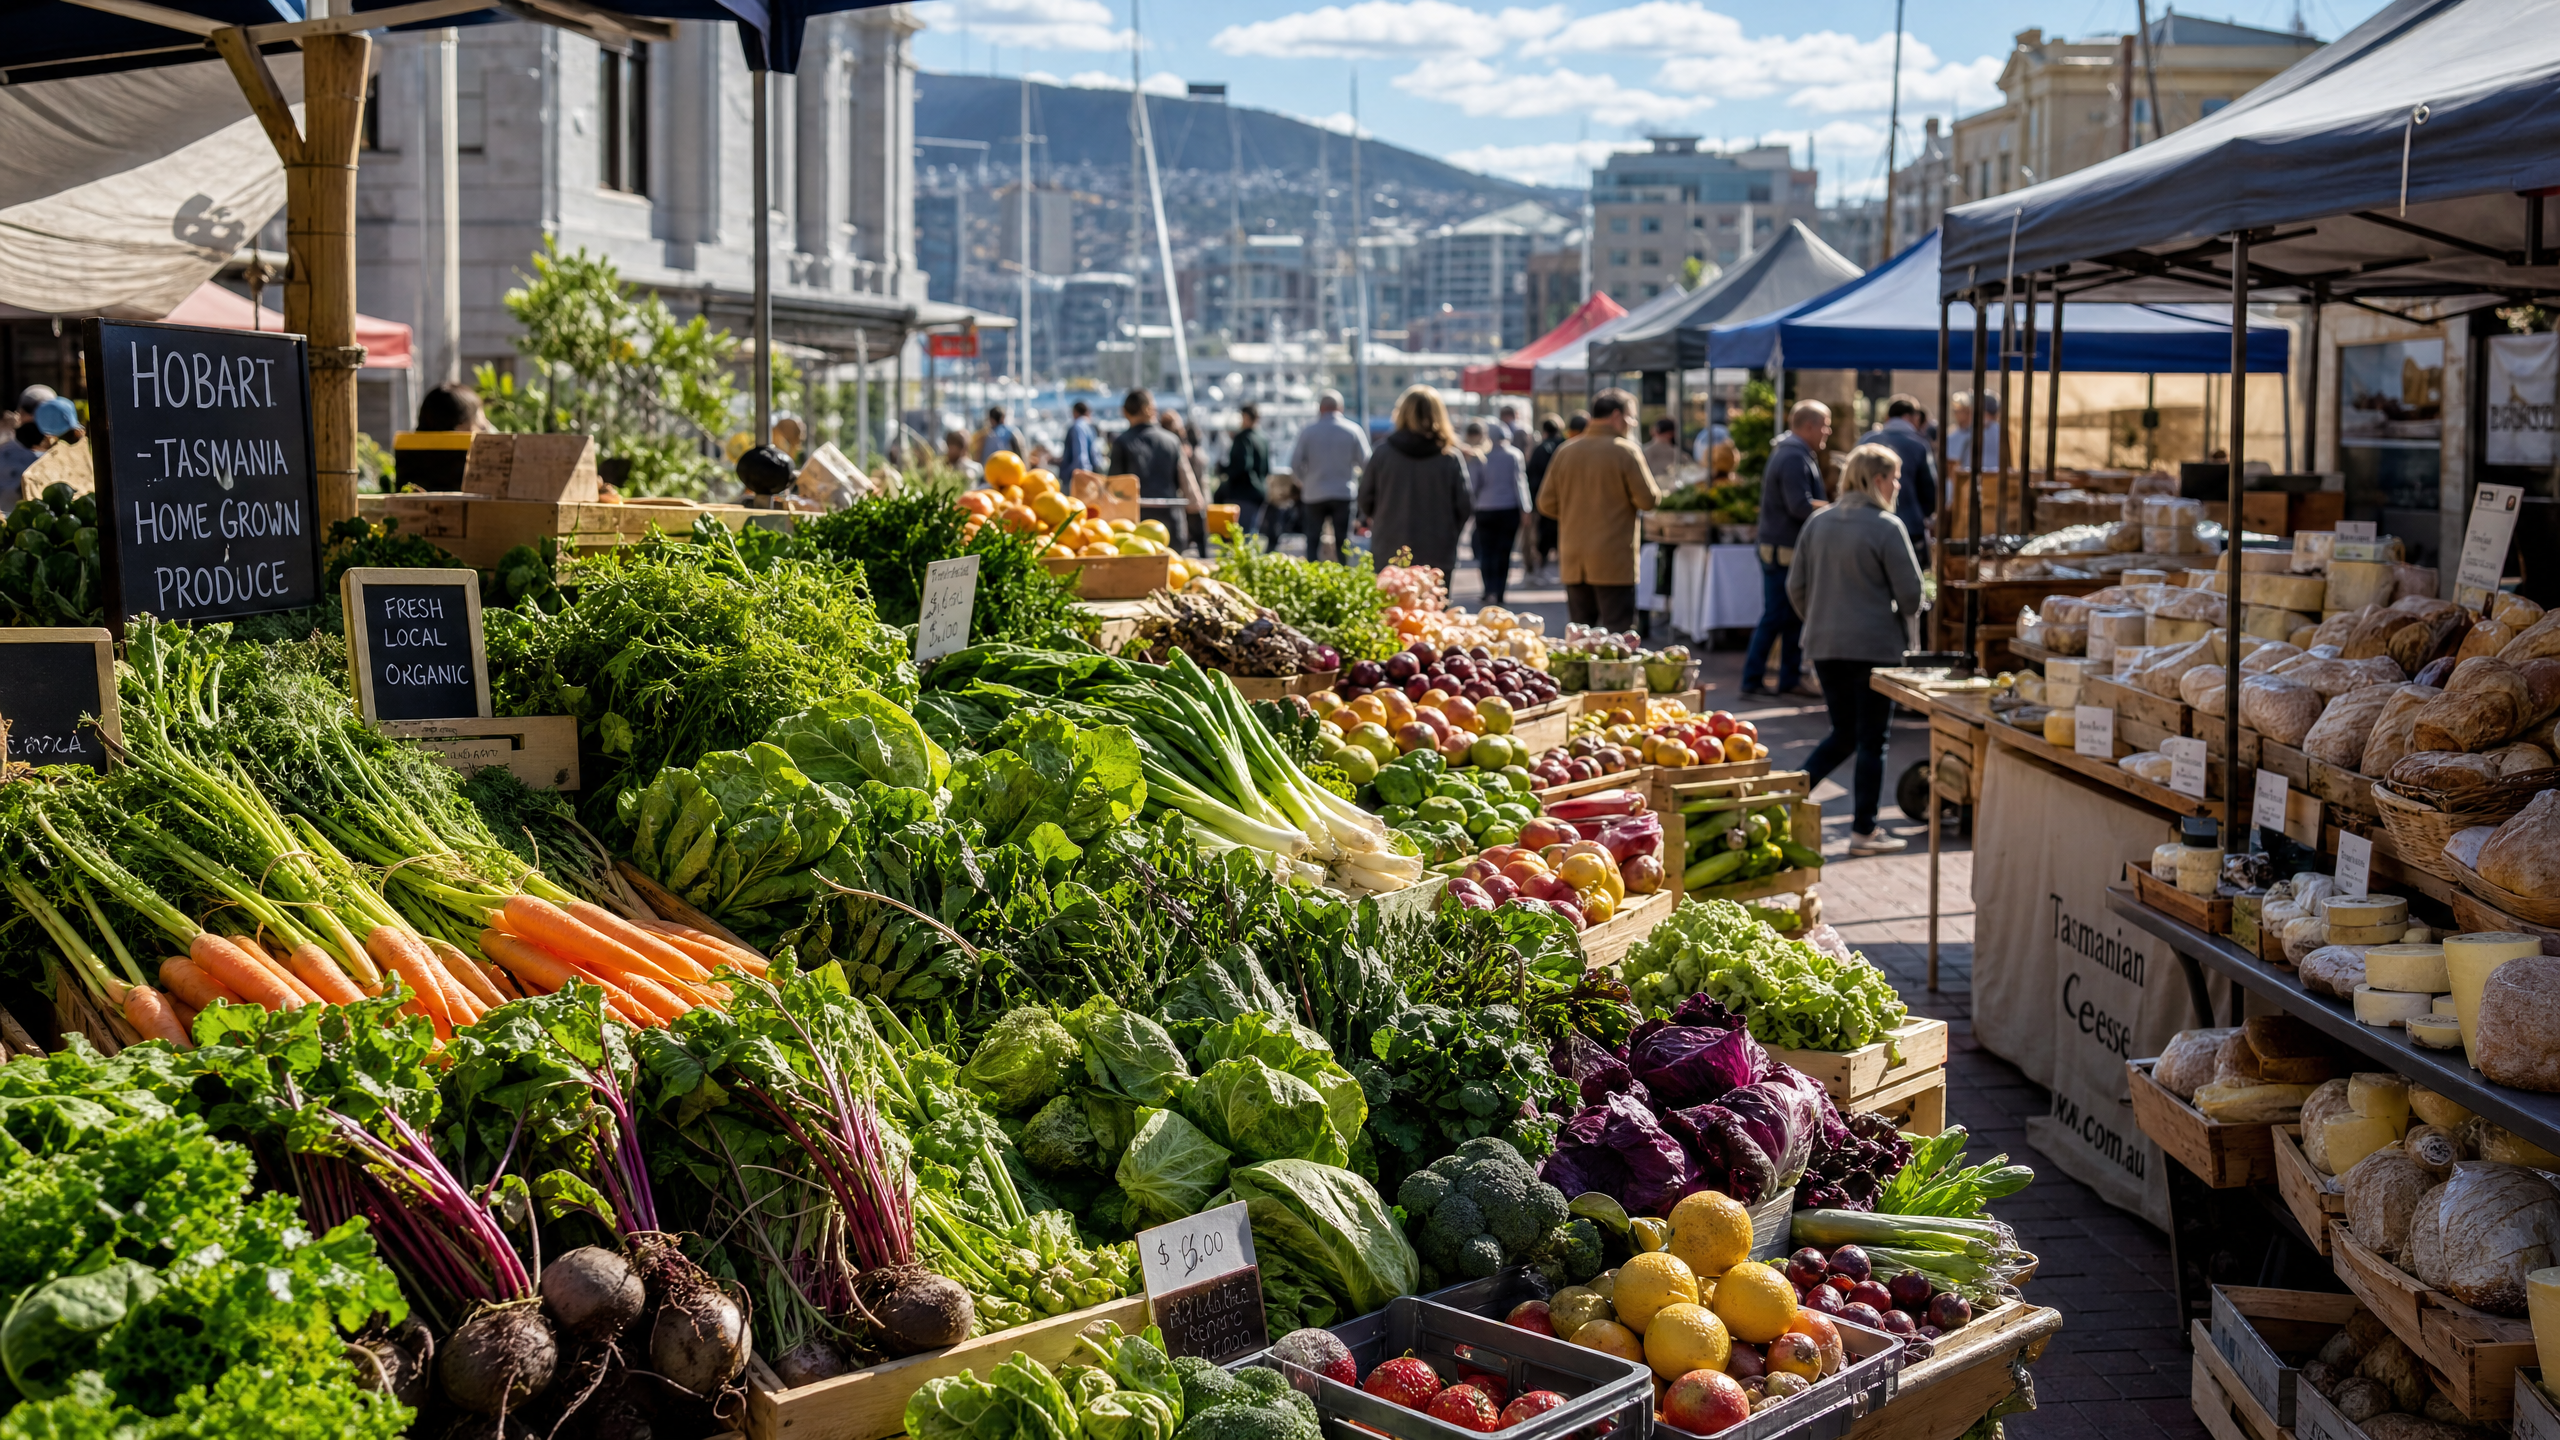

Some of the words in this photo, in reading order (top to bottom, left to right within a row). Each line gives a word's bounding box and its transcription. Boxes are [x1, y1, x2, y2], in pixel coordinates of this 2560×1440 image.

[131, 341, 275, 408] HOBART
[135, 500, 212, 545] HOME
[220, 498, 300, 539] GROWN
[156, 560, 289, 611] PRODUCE
[385, 597, 444, 619] FRESH
[384, 627, 448, 648] LOCAL
[385, 663, 469, 686] ORGANIC
[2050, 892, 2145, 987] Tasmanian
